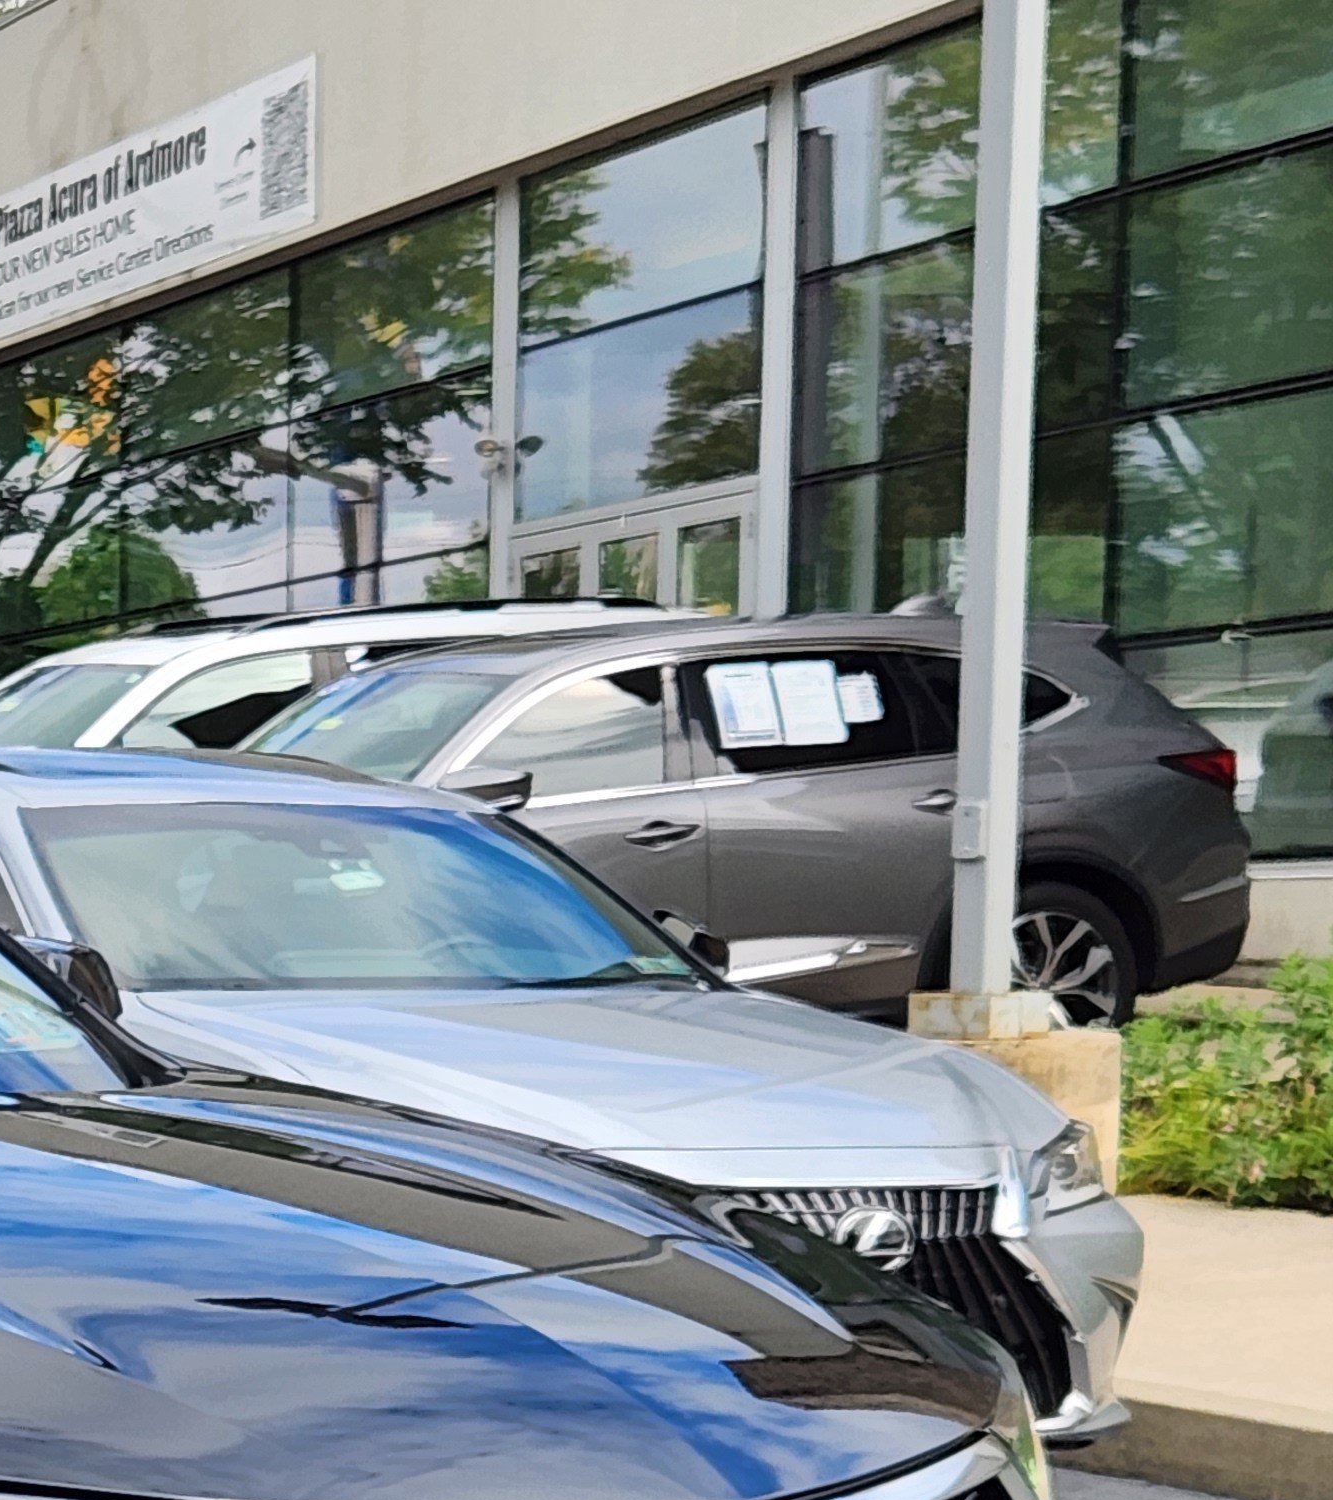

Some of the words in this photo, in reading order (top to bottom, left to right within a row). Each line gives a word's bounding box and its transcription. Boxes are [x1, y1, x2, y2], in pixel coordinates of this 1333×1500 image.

[47, 174, 97, 229] Acura
[103, 155, 121, 205] of
[124, 126, 207, 197] Ardmore
[54, 227, 91, 264] SALES
[93, 208, 136, 249] HOME
[76, 260, 116, 291] Service
[154, 223, 215, 261] Directions
